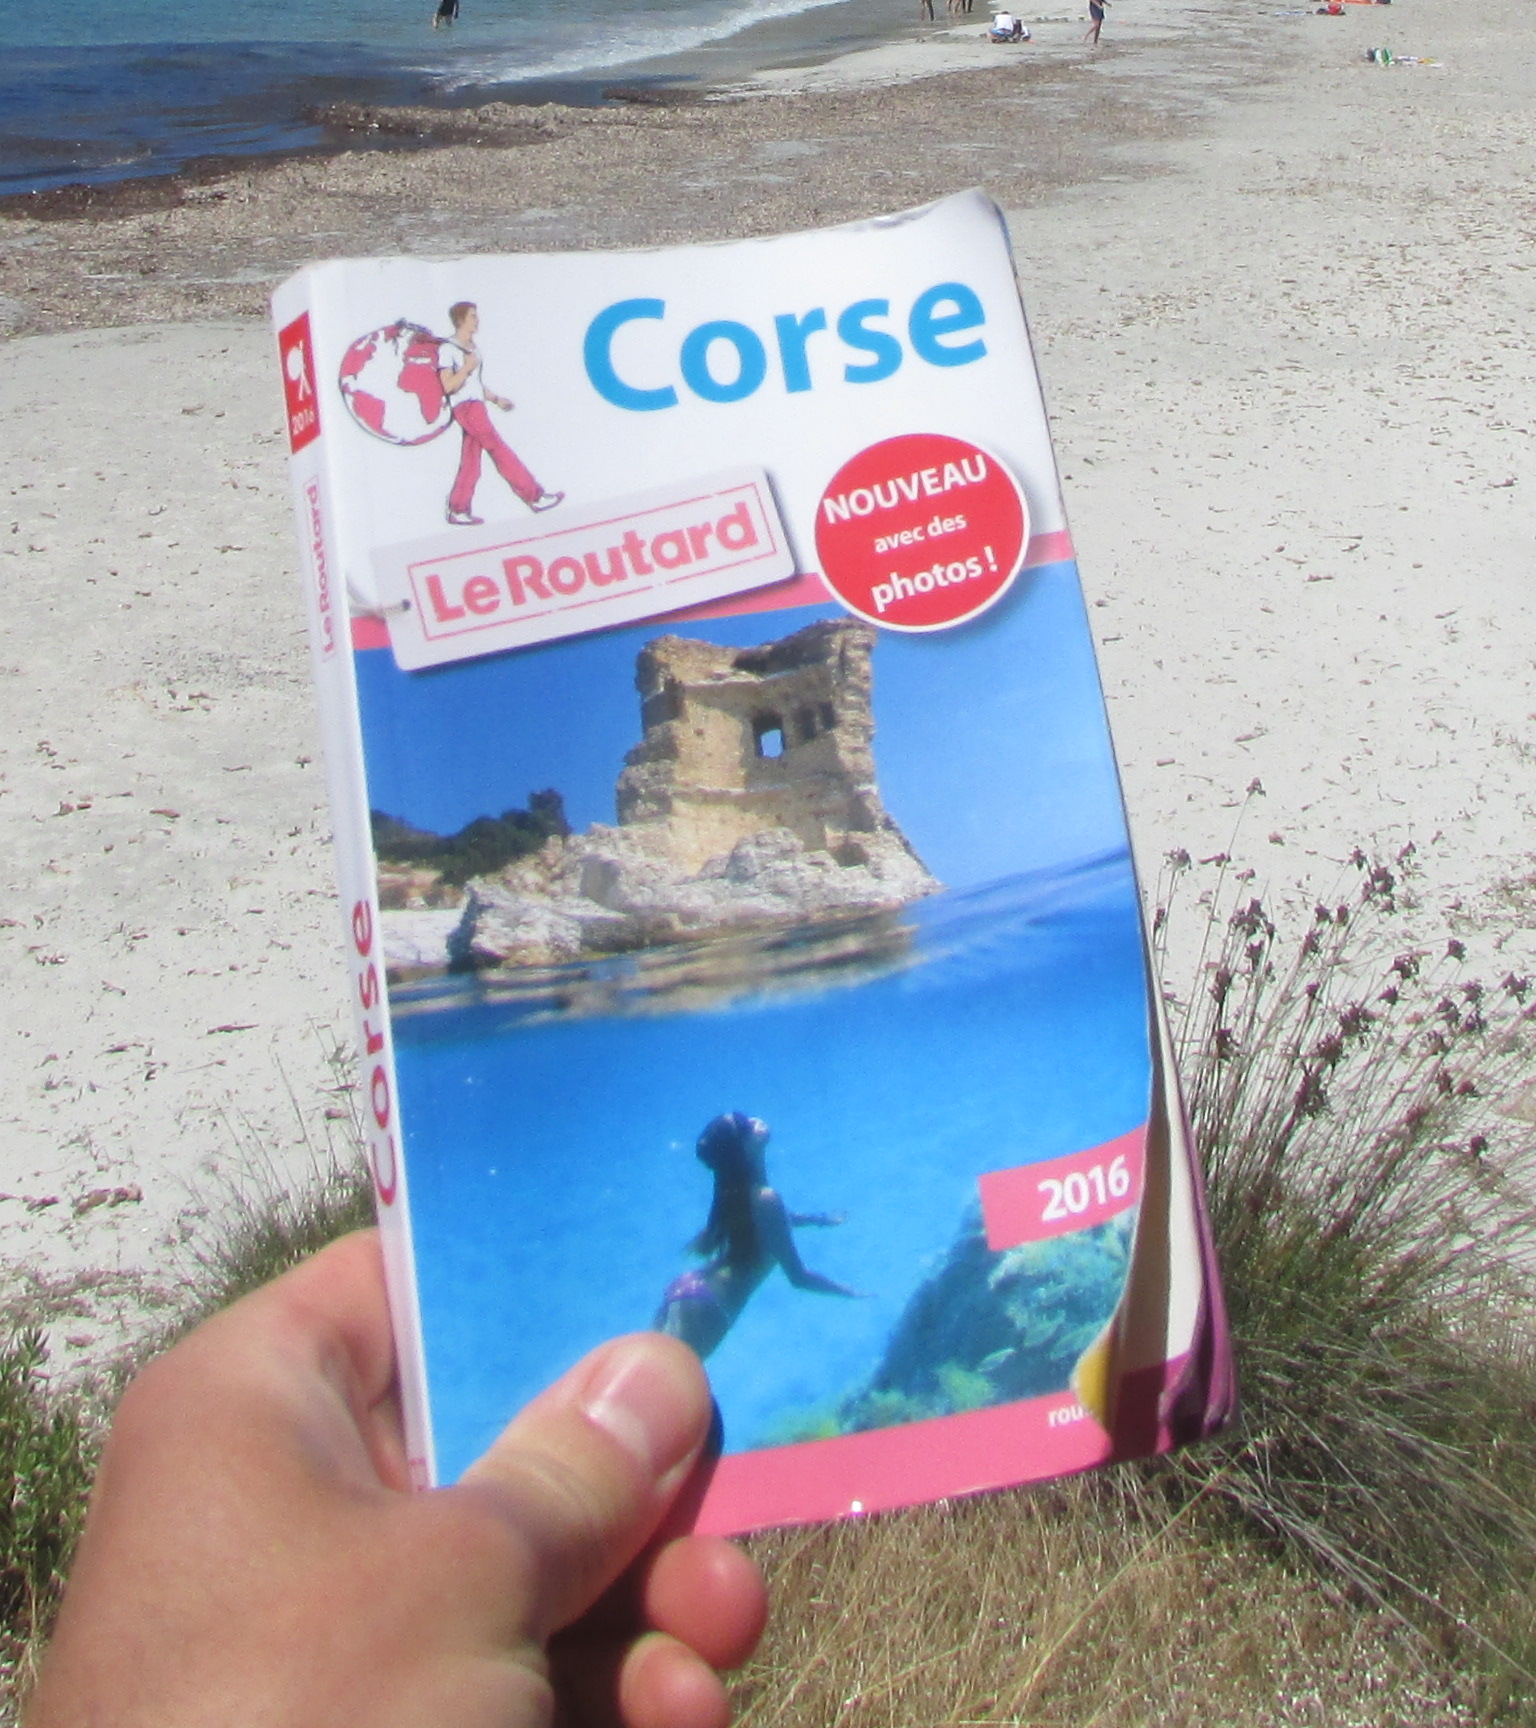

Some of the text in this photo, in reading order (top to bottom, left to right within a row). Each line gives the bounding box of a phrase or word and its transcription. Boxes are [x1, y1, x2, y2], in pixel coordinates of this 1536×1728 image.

[583, 281, 987, 411] Corse
[823, 454, 988, 524] NOUVEAU
[306, 484, 331, 613] Routard
[425, 501, 758, 623] Le Routard
[874, 514, 967, 553] avec des
[871, 545, 998, 613] photos !
[352, 900, 397, 1206] Corse
[1037, 1154, 1130, 1222] 2016
[1048, 1405, 1088, 1427] rou
